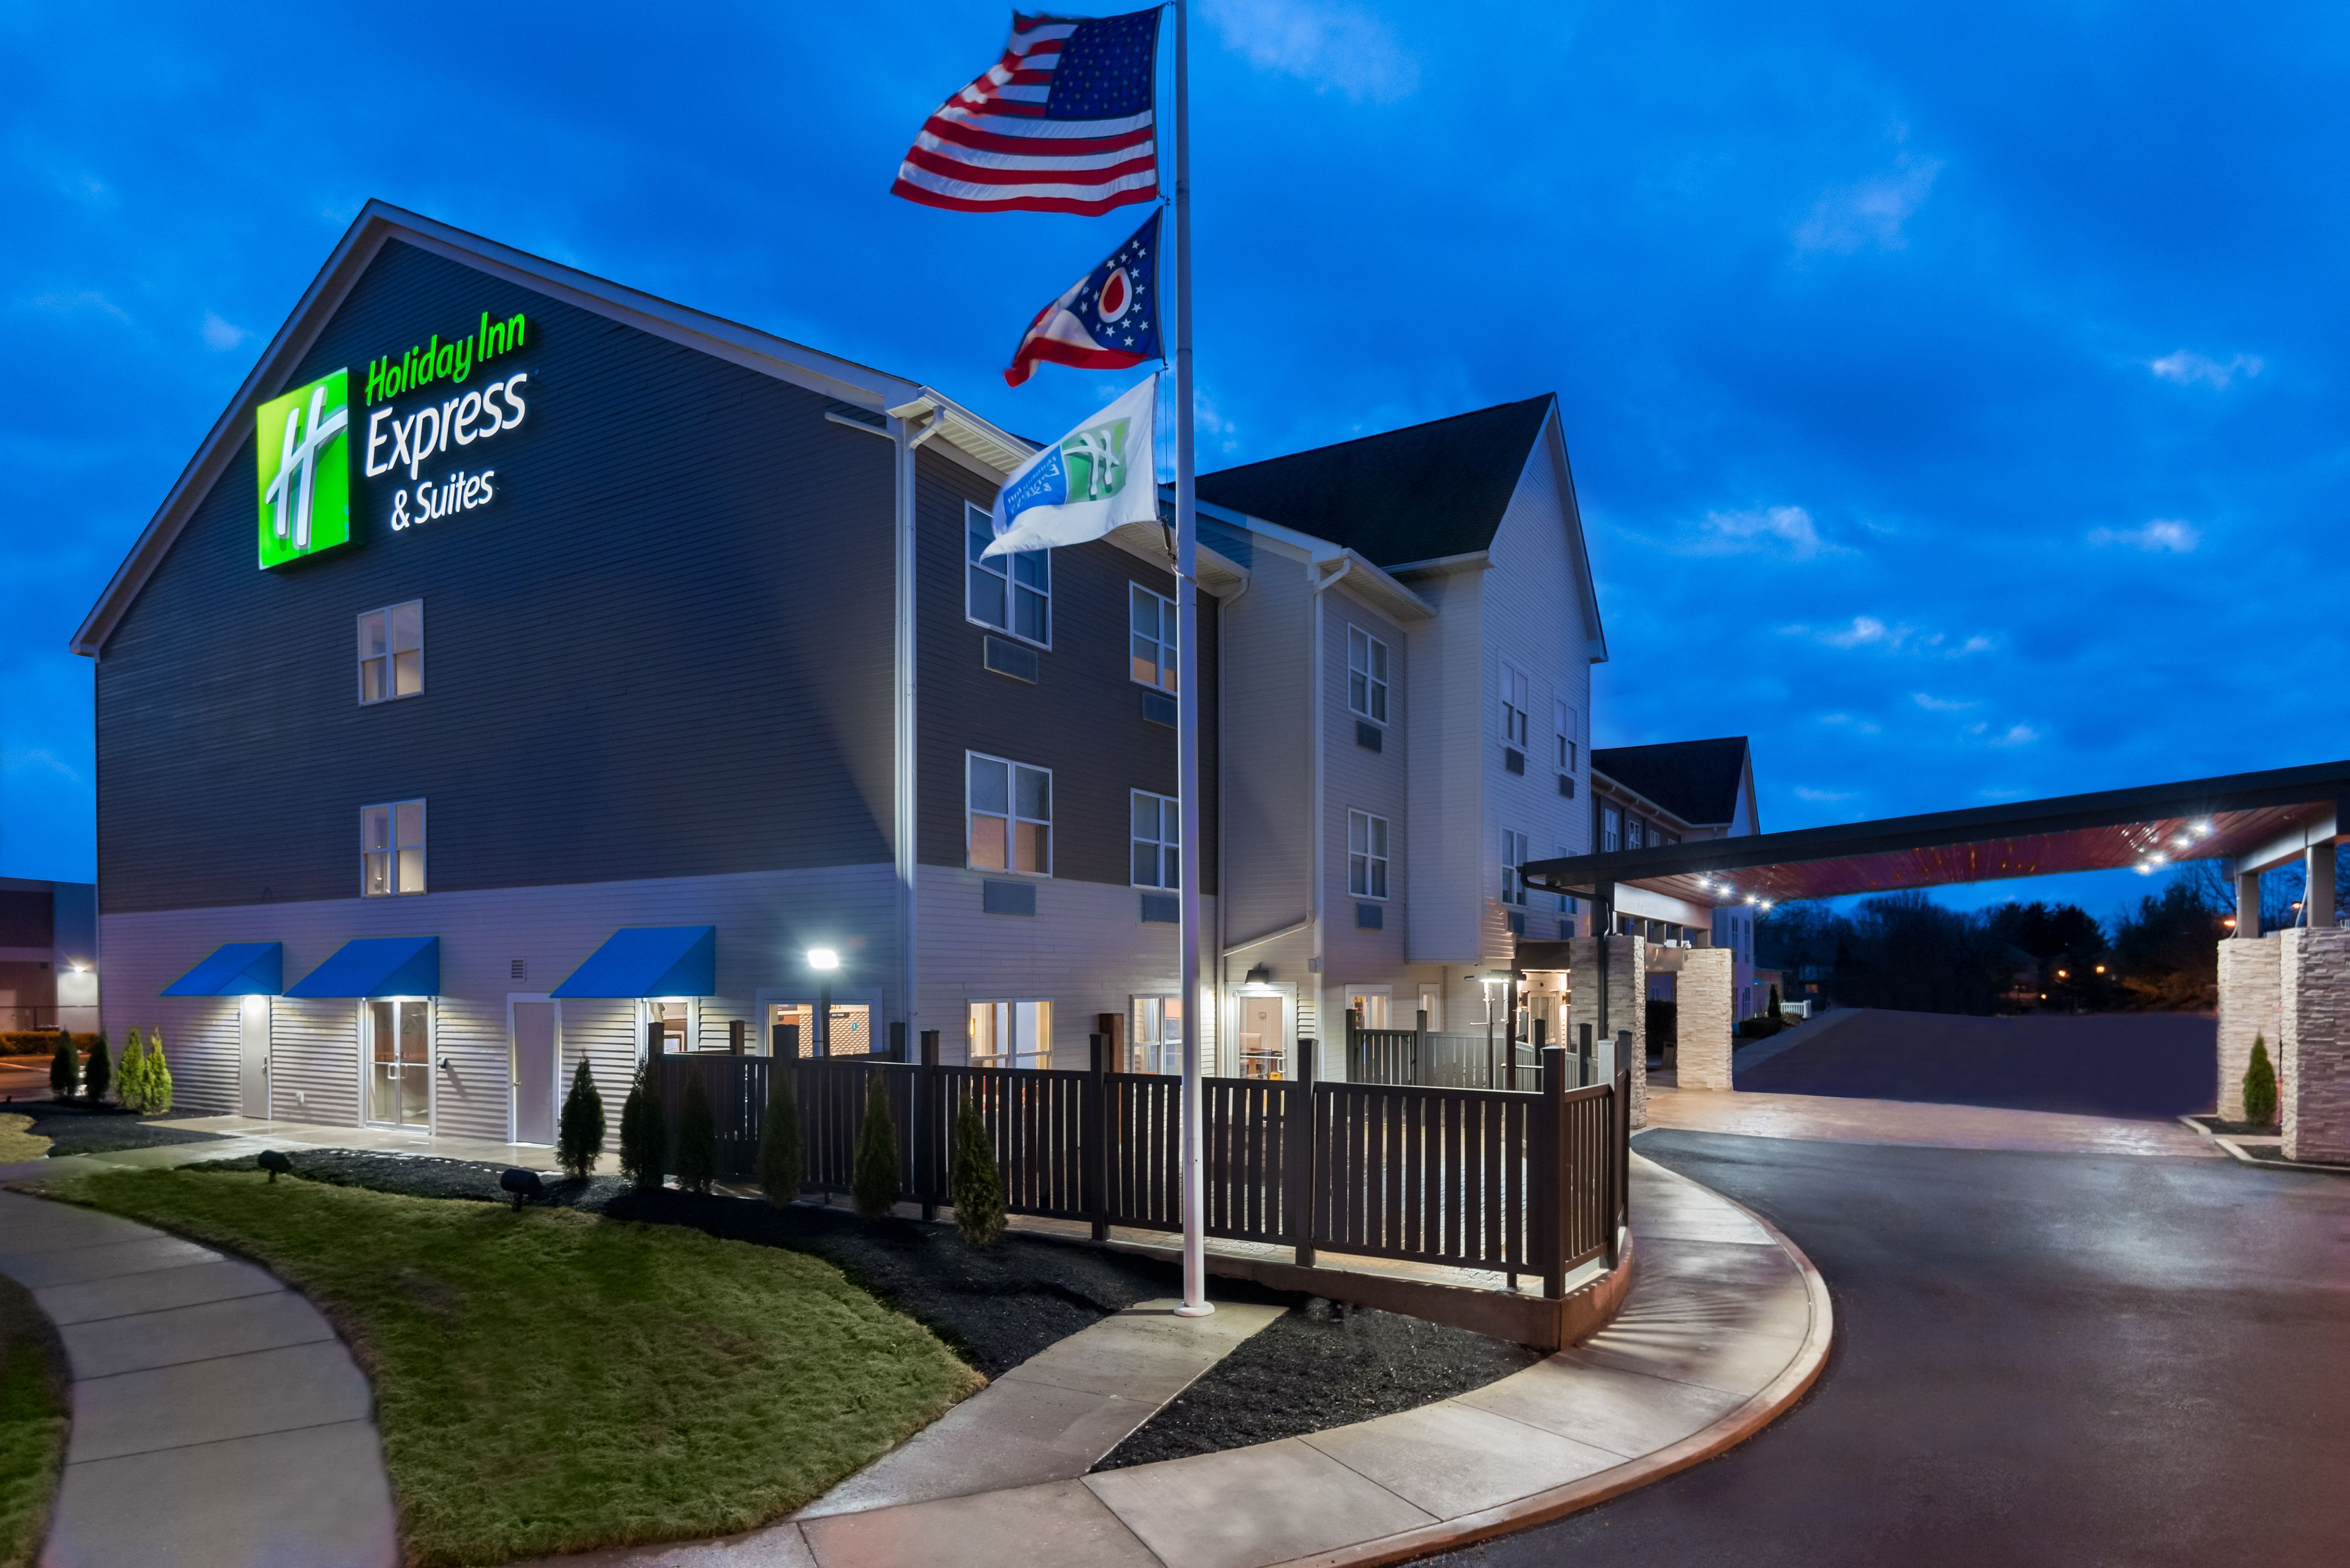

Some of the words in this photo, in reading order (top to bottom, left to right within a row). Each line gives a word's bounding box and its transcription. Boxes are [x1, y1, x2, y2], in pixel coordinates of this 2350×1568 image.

[365, 335, 473, 406] Holiday
[478, 312, 526, 362] Inn
[366, 373, 528, 480] Express
[391, 490, 411, 531] &
[415, 471, 495, 525] Suites
